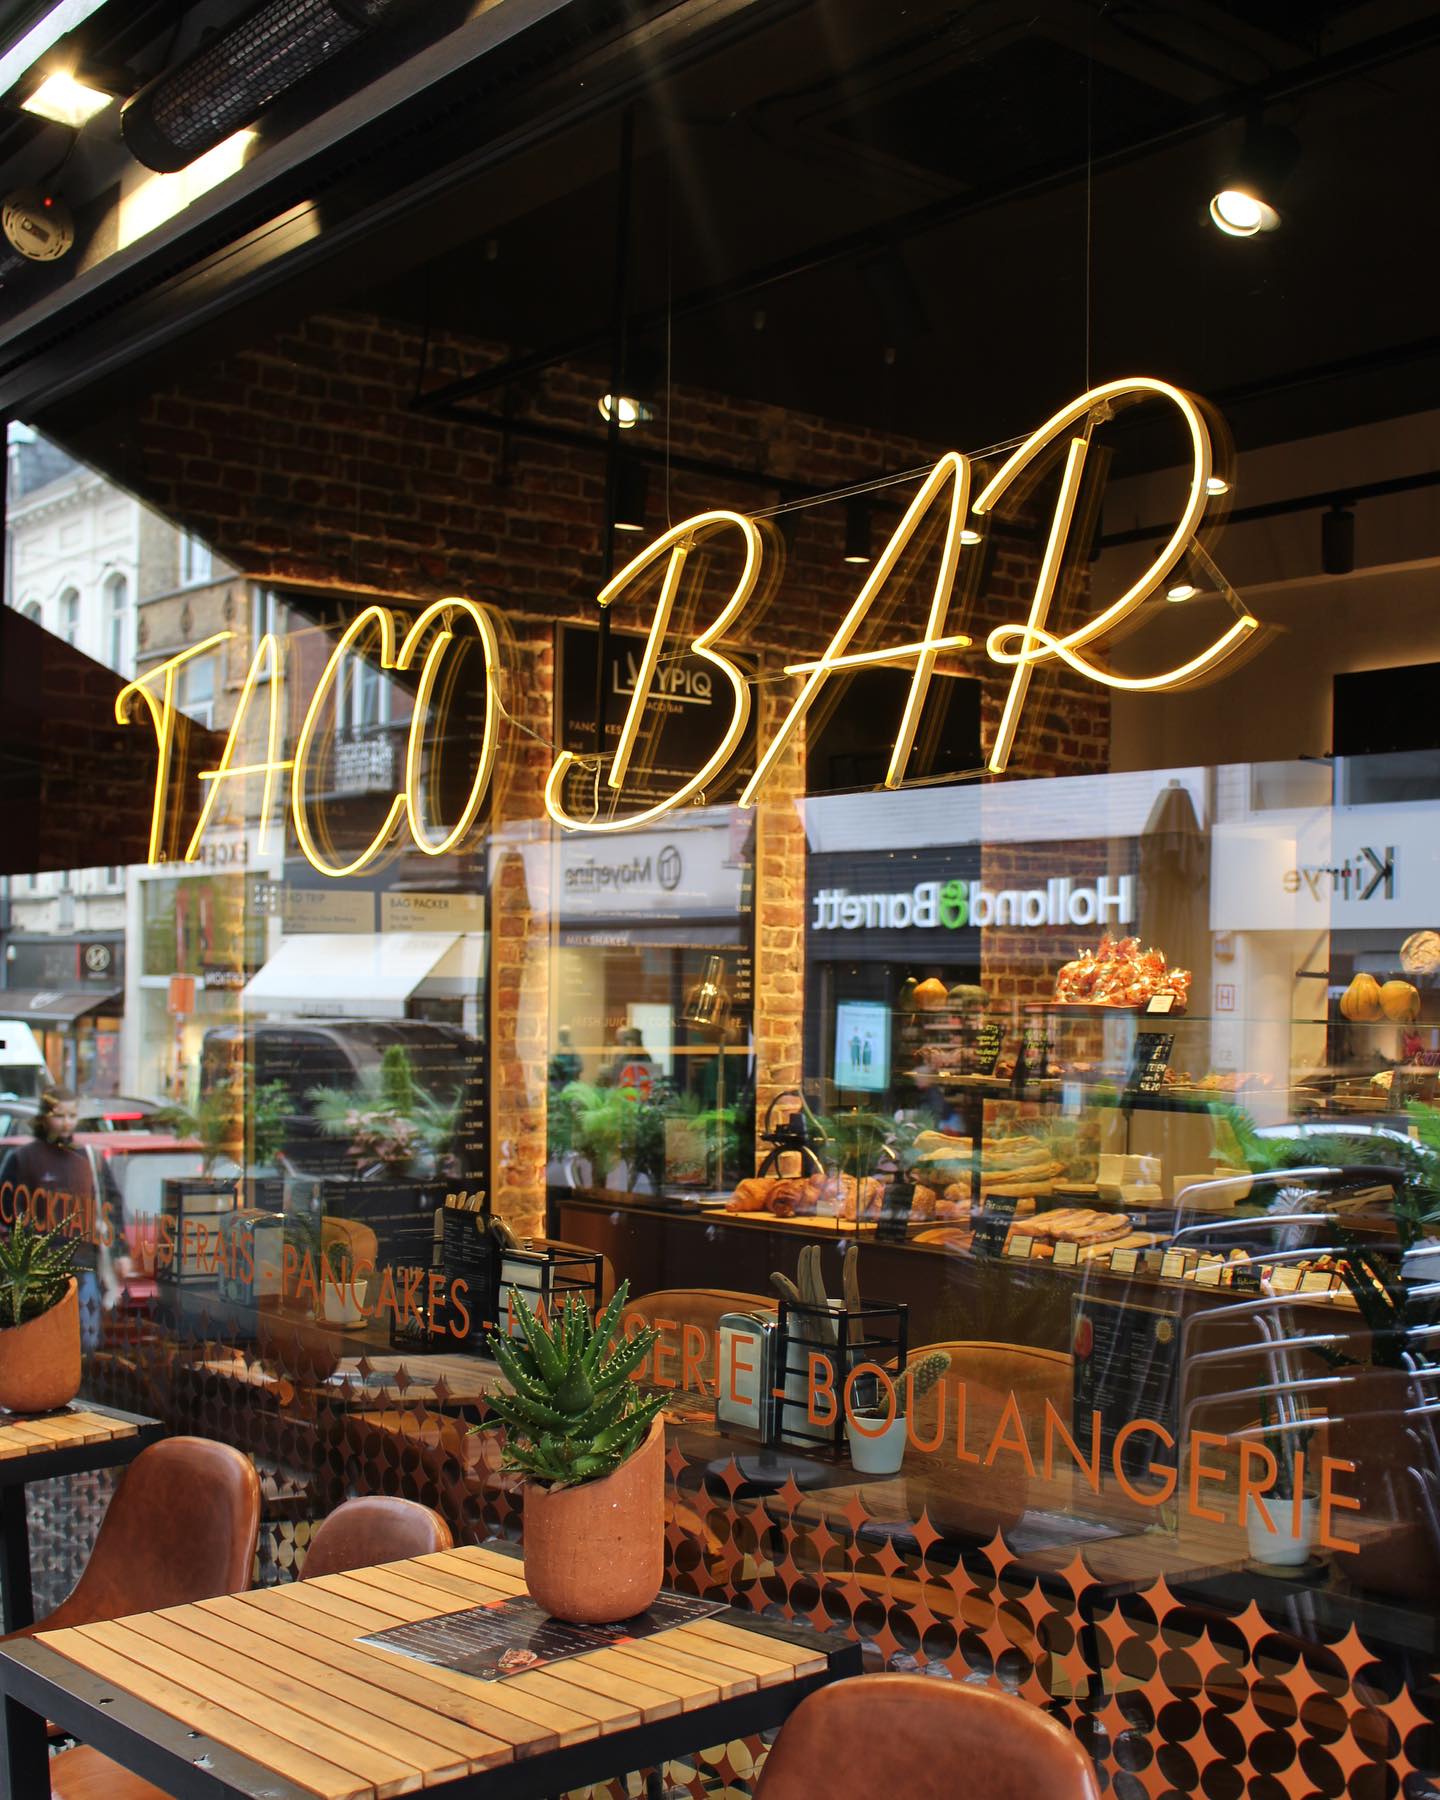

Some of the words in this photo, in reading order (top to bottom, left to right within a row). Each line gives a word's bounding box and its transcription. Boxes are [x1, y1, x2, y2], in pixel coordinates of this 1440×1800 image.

[115, 597, 500, 877] TACO
[544, 376, 1260, 834] BAR
[568, 720, 625, 735] PANCKES
[1, 1180, 114, 1248] COCKTAILS
[131, 1209, 174, 1265] JUS
[182, 1219, 255, 1285] FRAIS
[283, 1243, 470, 1339] PANCAKES
[808, 1351, 1360, 1554] BOULANGERIE
